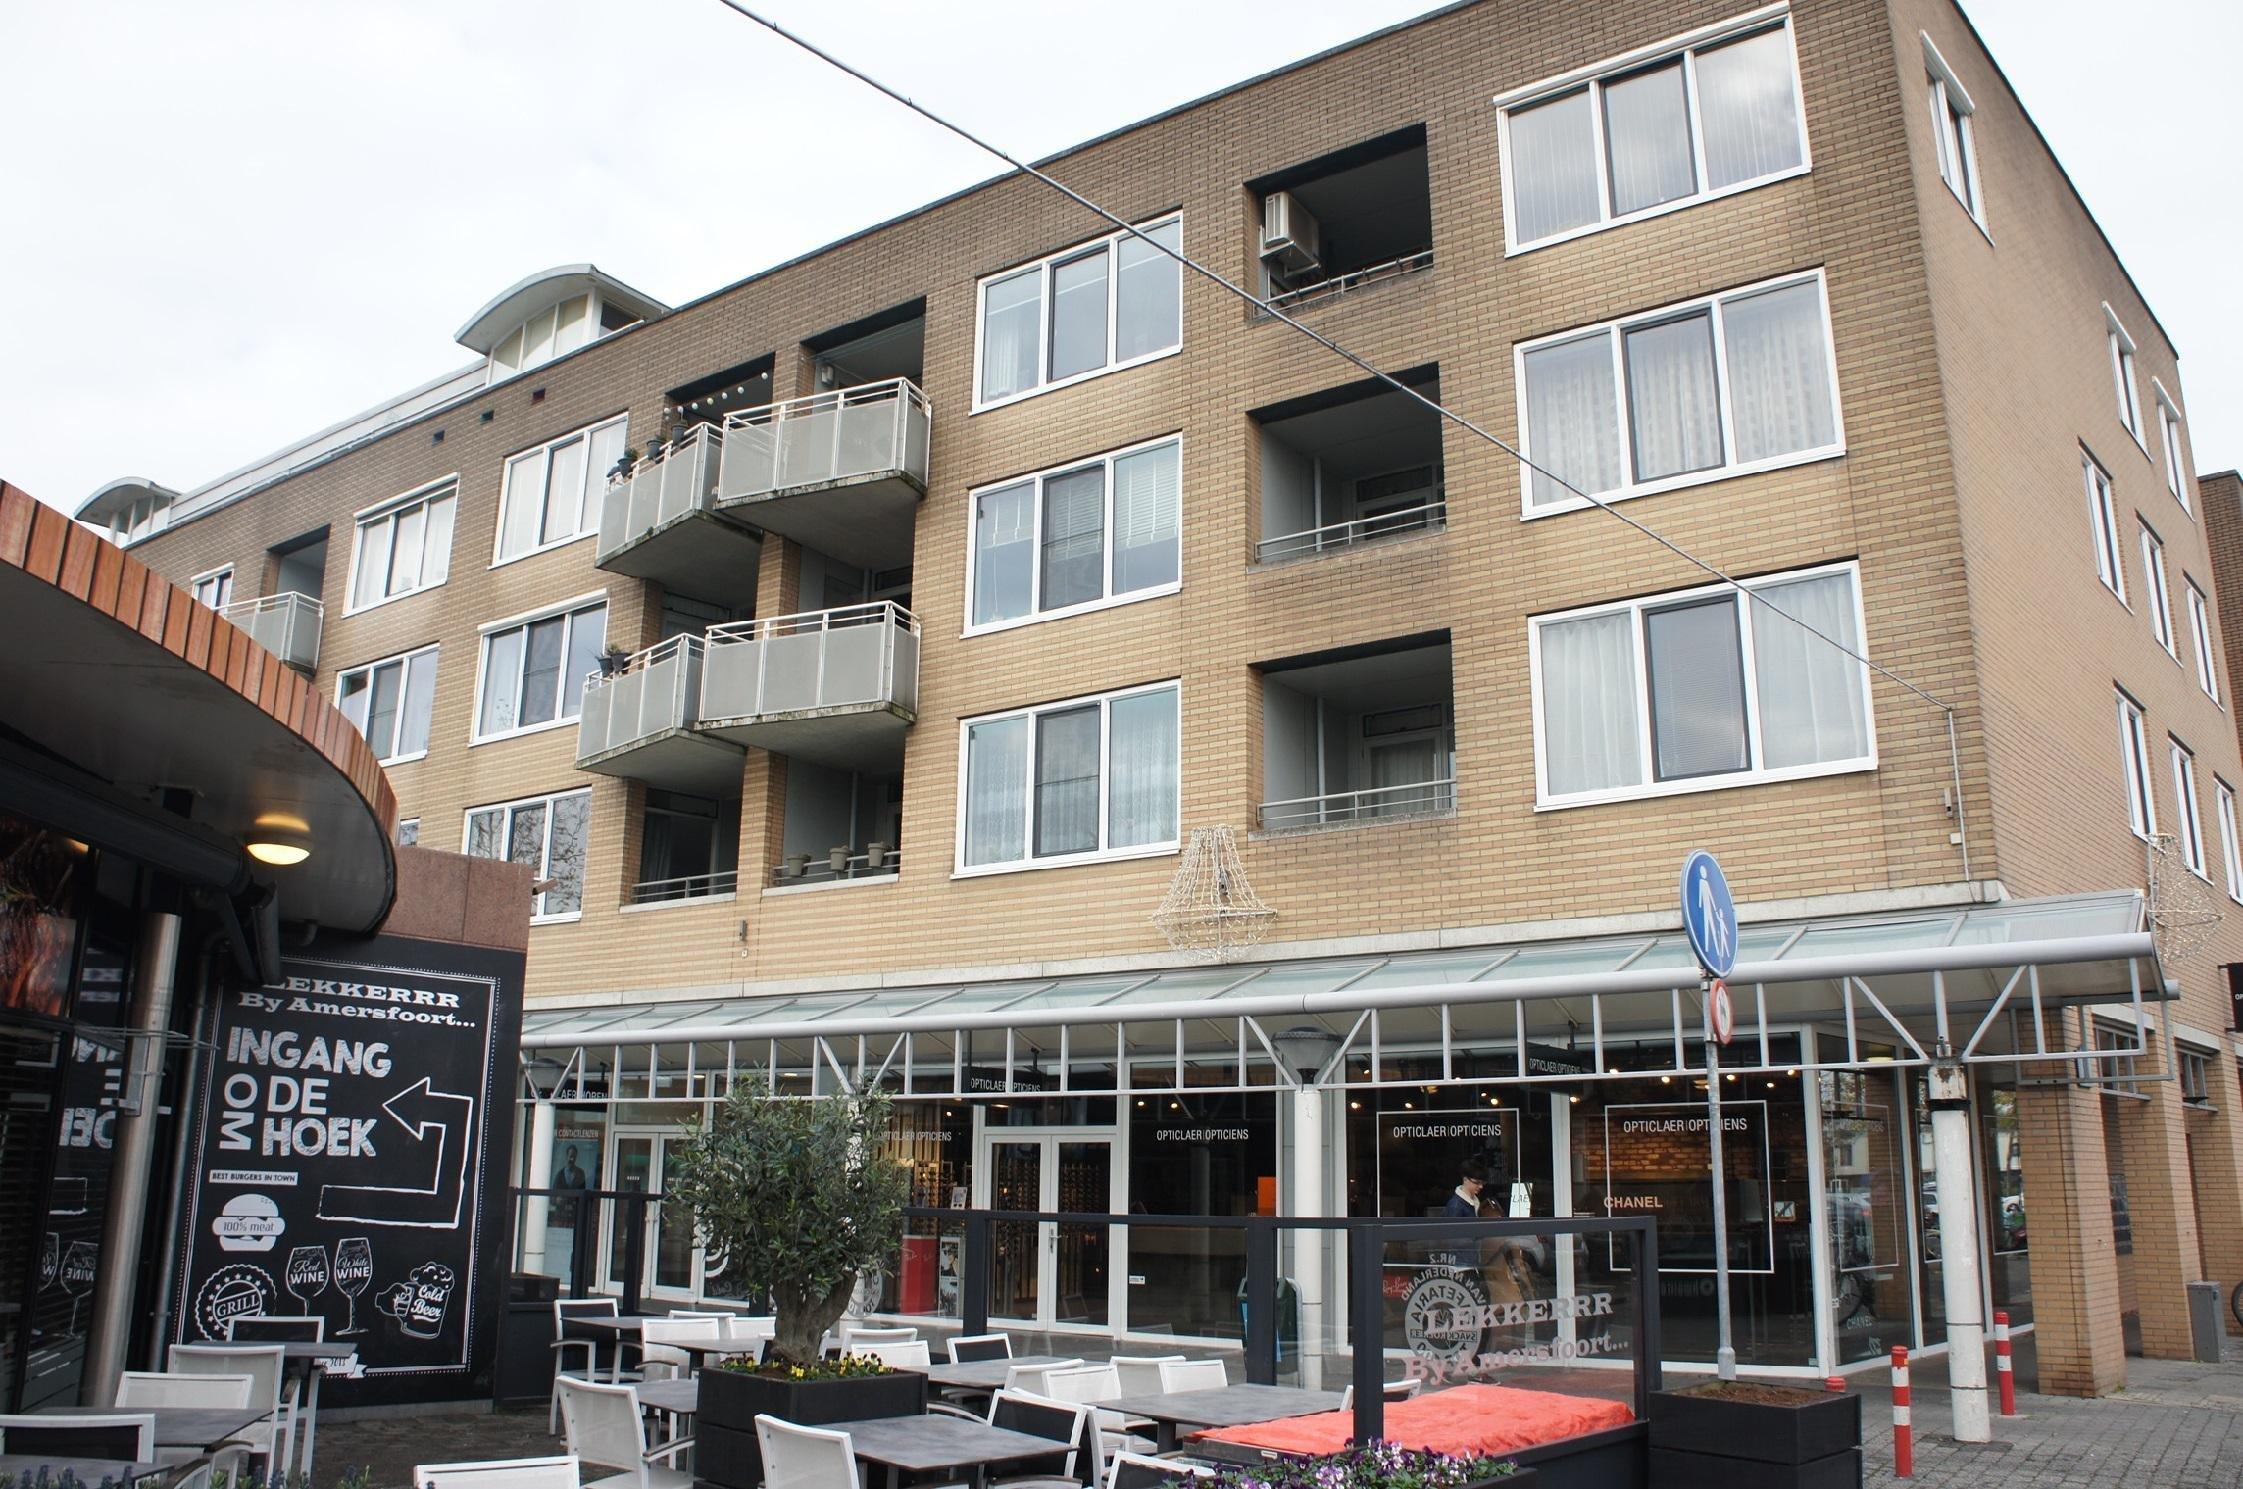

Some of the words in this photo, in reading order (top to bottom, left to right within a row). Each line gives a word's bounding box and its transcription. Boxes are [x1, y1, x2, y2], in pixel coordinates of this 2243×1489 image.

[238, 992, 287, 1013] By
[288, 997, 476, 1028] Amersfoort...
[226, 1026, 392, 1078] INGANG
[266, 1075, 330, 1115] DE
[1012, 1082, 1041, 1092] PTICIENS
[219, 1072, 258, 1151] OM
[1393, 1124, 1447, 1139] OPTICLAER
[1450, 1123, 1501, 1137] OPTICIENS
[1623, 1119, 1684, 1133] OPTICLAER
[1688, 1117, 1747, 1131] OPTIENS
[262, 1117, 378, 1157] HOEK
[917, 1131, 952, 1142] OPTICIENS
[1156, 1129, 1202, 1141] OPTICLAER
[1205, 1128, 1249, 1141] OPTICIENS
[212, 1172, 229, 1180] BEST
[230, 1172, 262, 1181] BURGERS
[264, 1173, 272, 1182] IN
[273, 1174, 296, 1182] TOWN
[1603, 1196, 1664, 1208] CHANEL
[223, 1221, 248, 1232] 100%
[250, 1222, 275, 1231] meat
[293, 1259, 321, 1273] Red
[336, 1266, 370, 1279] WINE
[290, 1270, 325, 1285] WINE
[418, 1286, 445, 1302] Cold
[216, 1294, 260, 1318] GRILL
[410, 1299, 442, 1317] Beer
[1423, 1292, 1614, 1336] LEKKERRR
[1404, 1356, 1447, 1386] By
